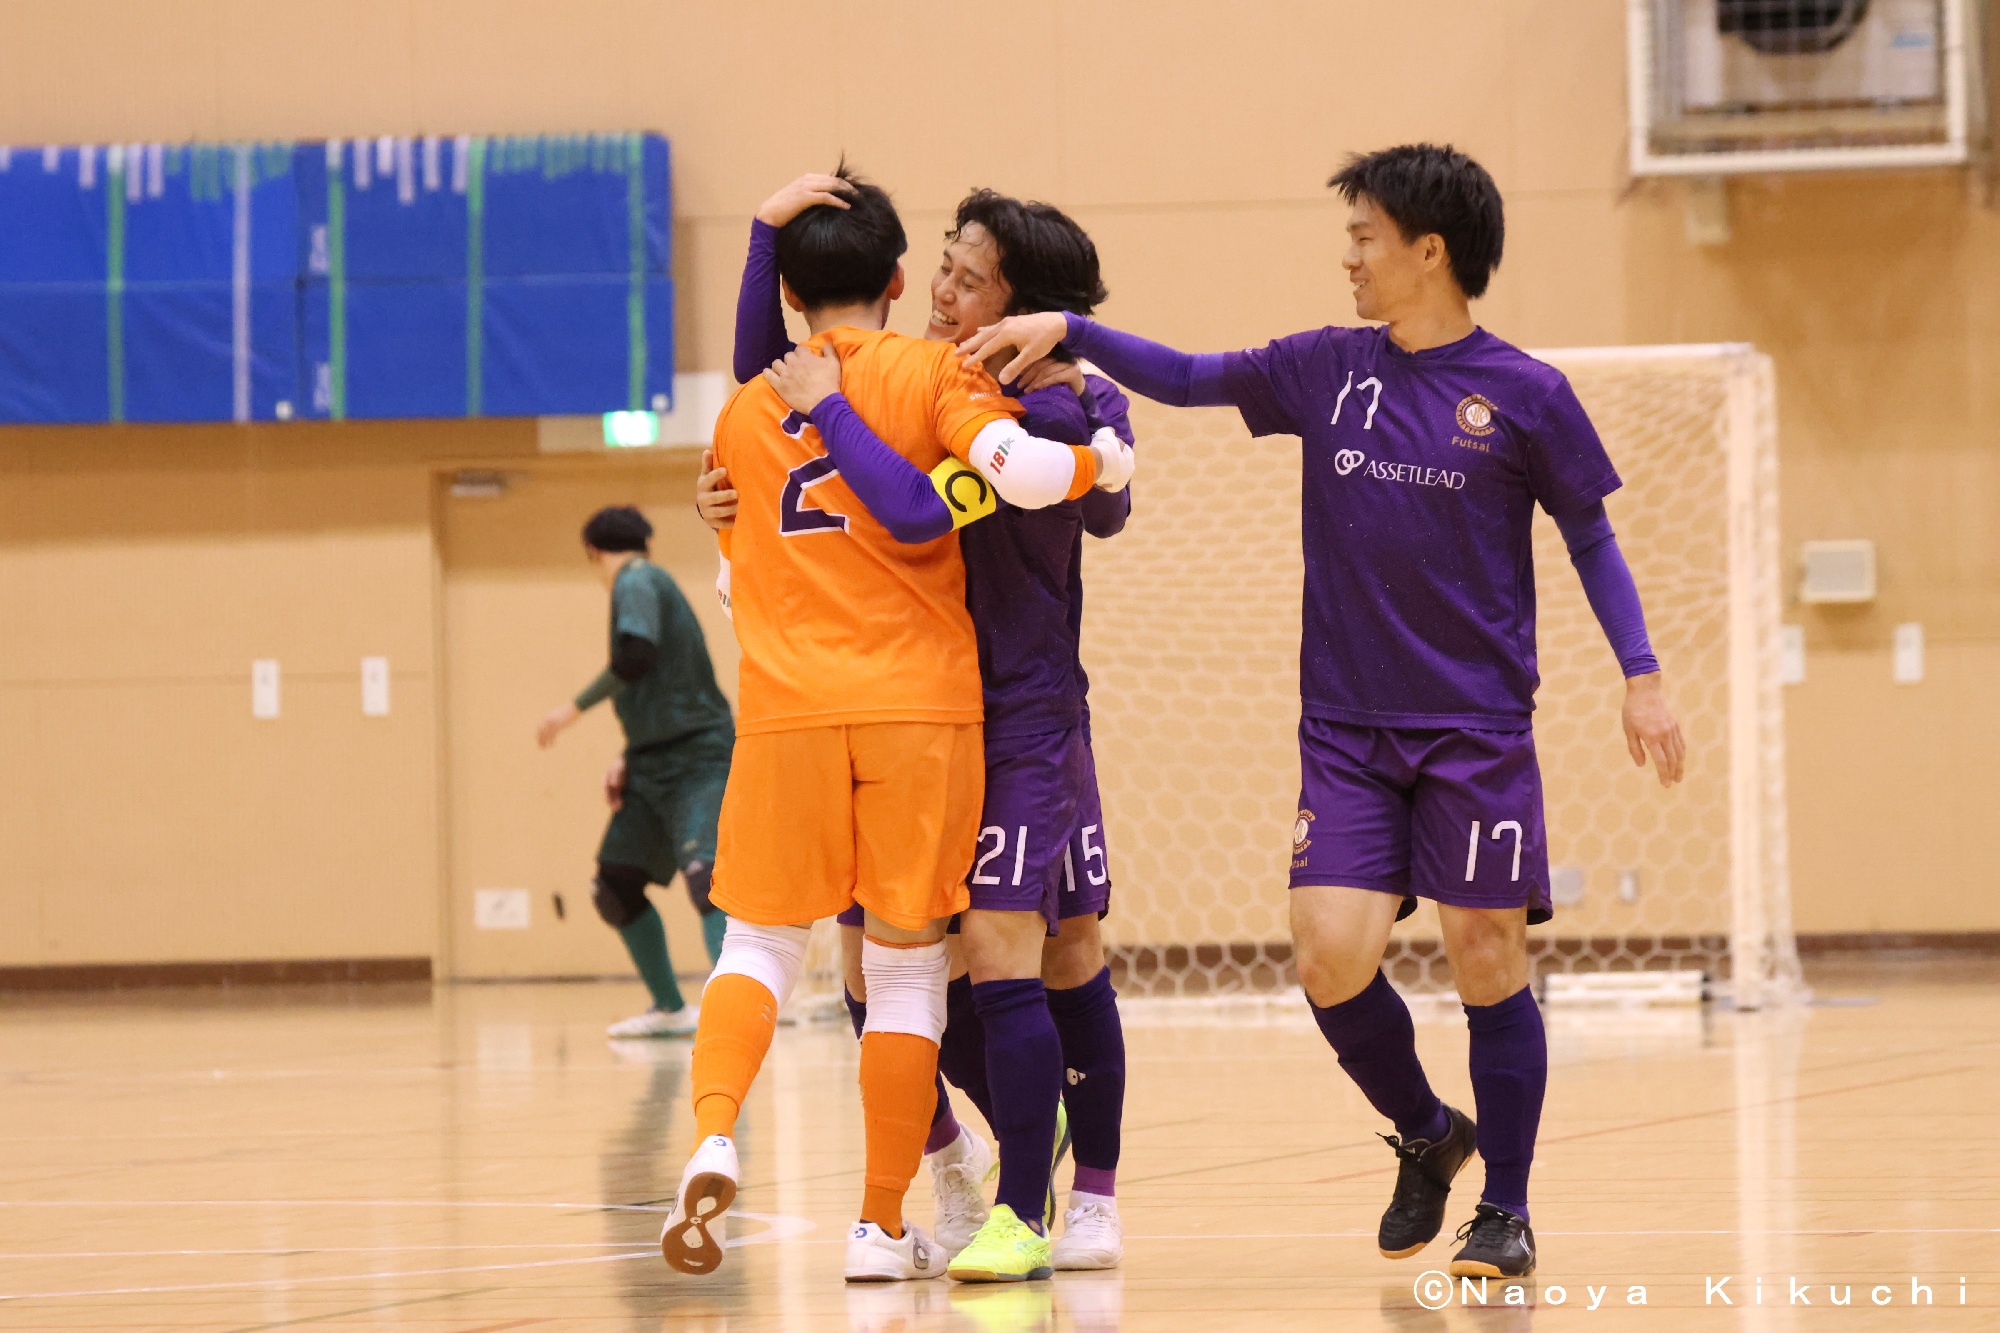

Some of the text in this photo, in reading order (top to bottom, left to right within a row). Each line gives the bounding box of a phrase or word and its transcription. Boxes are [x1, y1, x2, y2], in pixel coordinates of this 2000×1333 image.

[1330, 371, 1383, 430] 17
[1451, 435, 1490, 453] Futsal
[944, 470, 987, 512] C
[1363, 459, 1466, 490] ASSETLEAD
[972, 825, 1028, 886] 21
[1064, 824, 1107, 892] 15
[1464, 820, 1522, 882] 17
